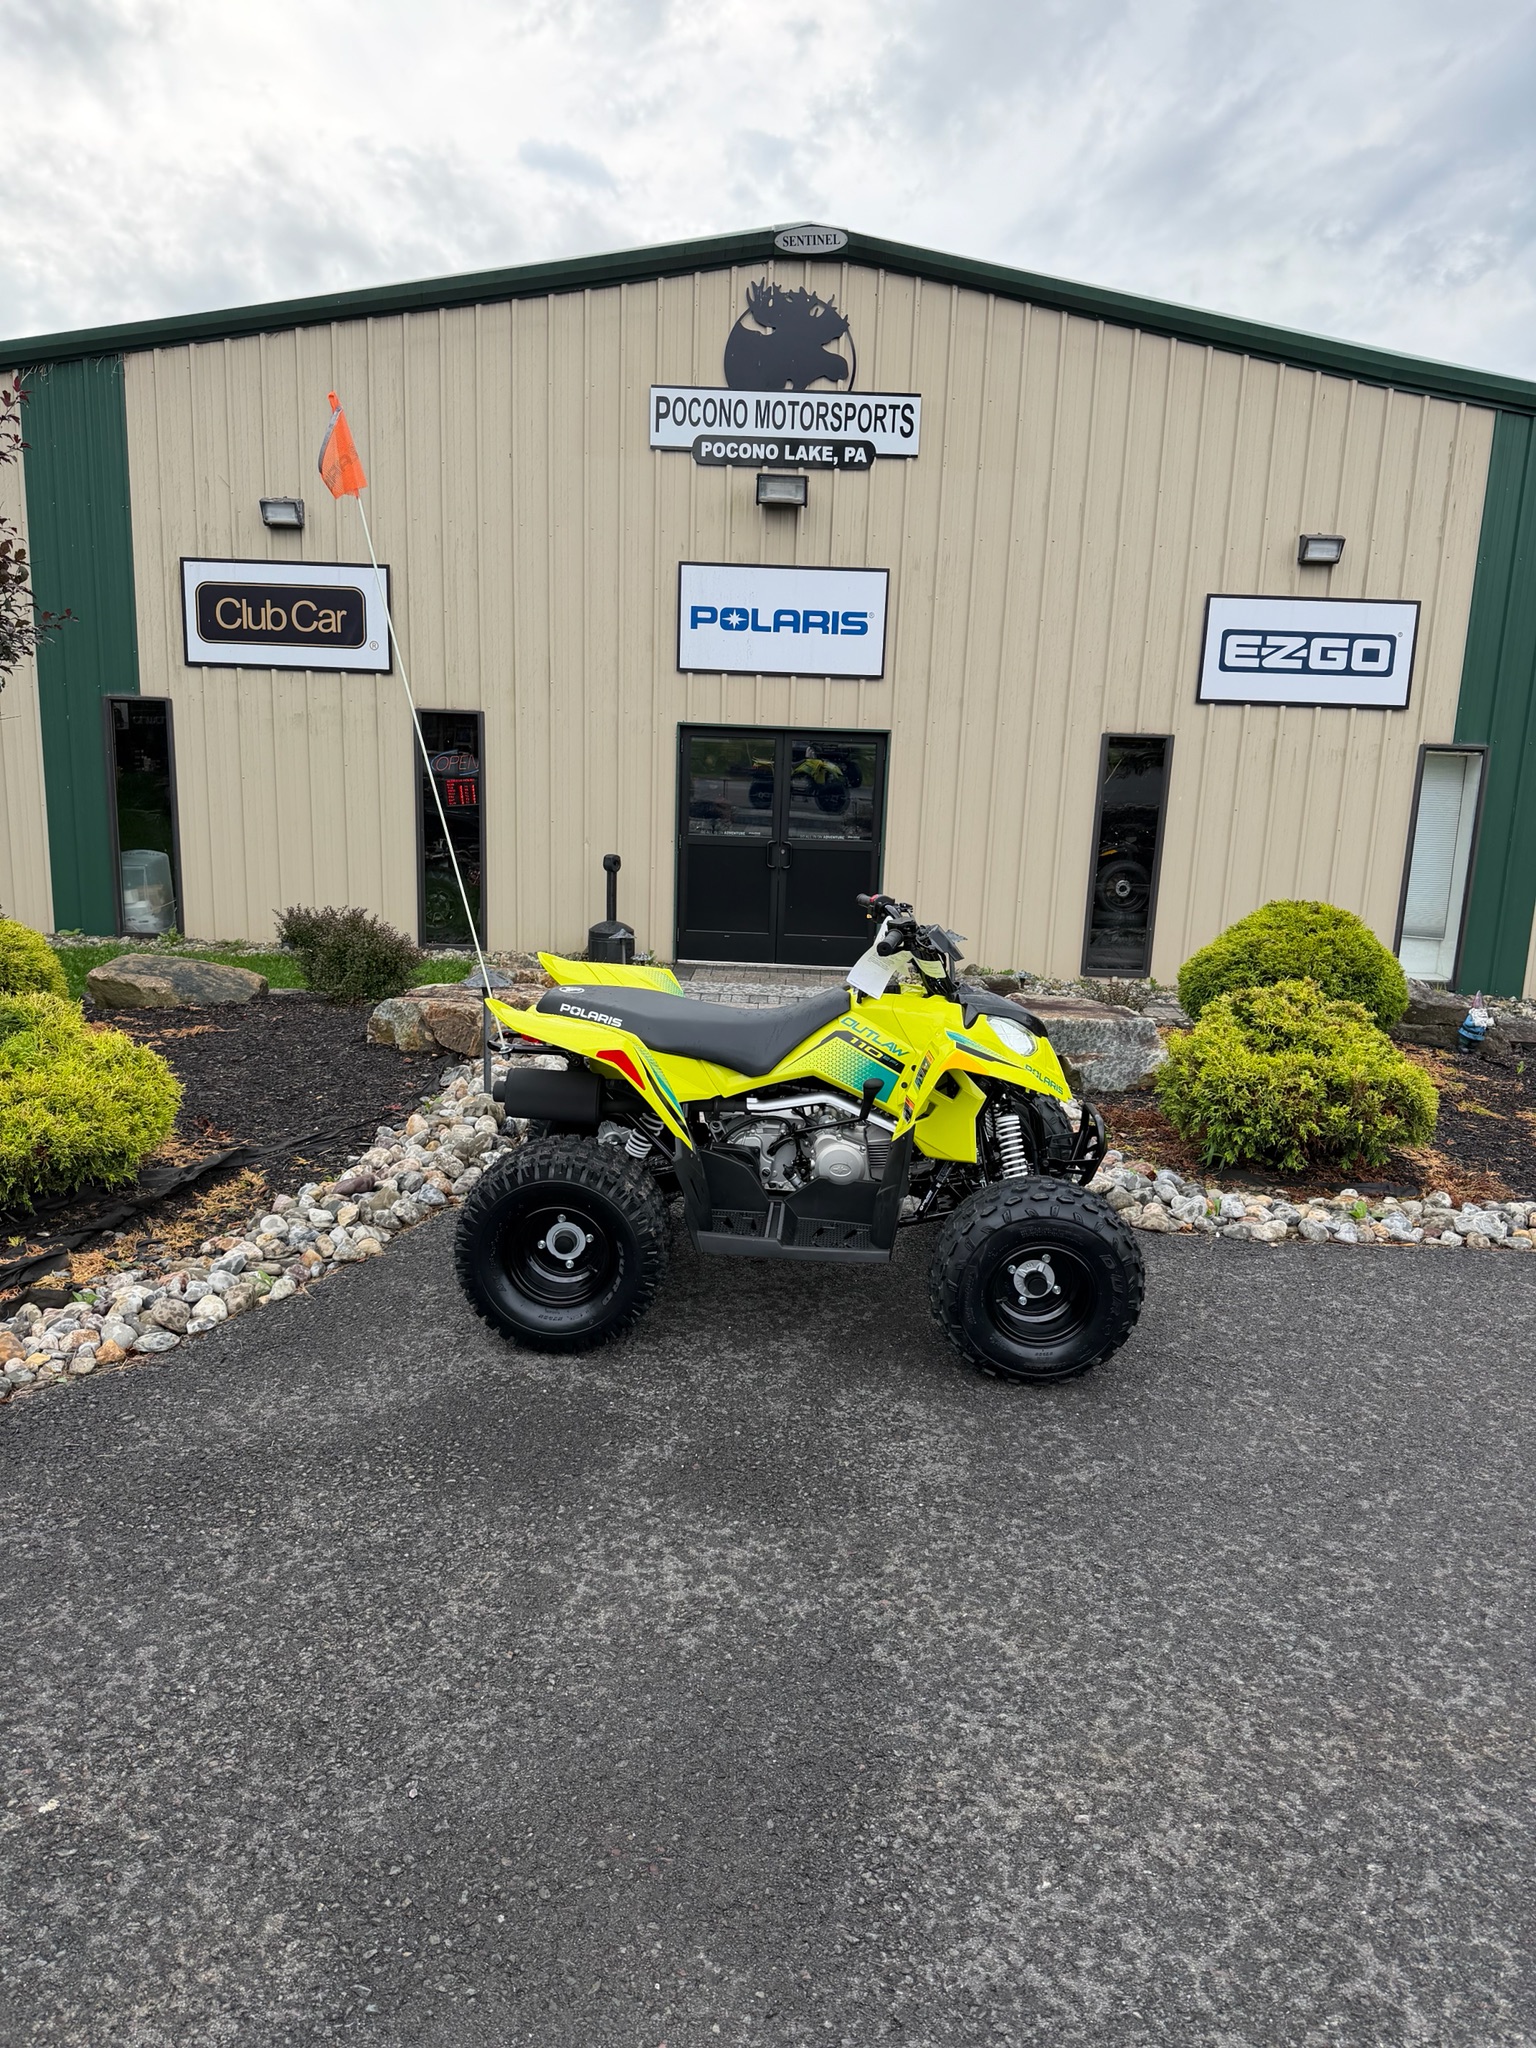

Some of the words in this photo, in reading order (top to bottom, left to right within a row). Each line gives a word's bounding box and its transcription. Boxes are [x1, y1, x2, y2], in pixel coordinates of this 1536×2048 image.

[782, 233, 841, 247] SENTINEL
[655, 395, 748, 433] POCONO
[754, 399, 915, 438] MOTORSPORTS
[701, 441, 779, 460] POCONO
[784, 444, 838, 465] LAKE,
[844, 446, 867, 463] PA
[215, 597, 288, 631] Club
[291, 600, 348, 633] Car
[690, 605, 869, 635] POLARIS
[1223, 634, 1392, 673] EZGO
[436, 754, 479, 771] OPEN
[560, 1003, 623, 1028] POLARIS
[840, 1017, 910, 1057] OUTLAW
[850, 1037, 884, 1058] 110
[1025, 1064, 1064, 1095] POLARIS
[602, 1240, 625, 1306] DURO
